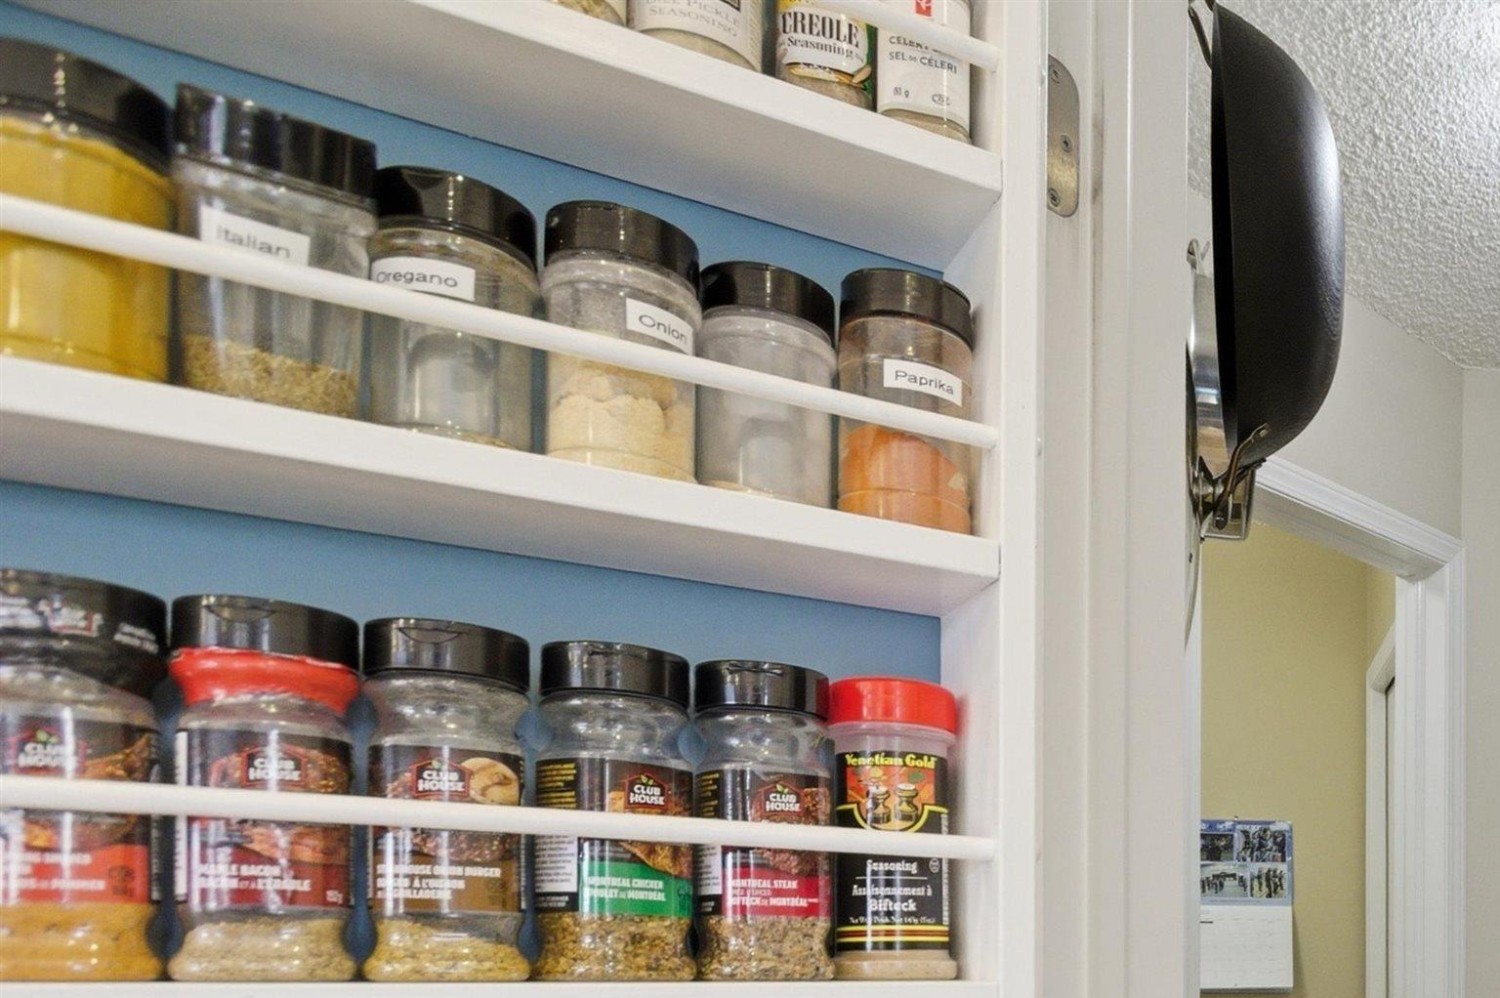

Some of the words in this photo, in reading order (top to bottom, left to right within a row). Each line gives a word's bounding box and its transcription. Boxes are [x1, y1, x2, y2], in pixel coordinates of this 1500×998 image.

[648, 6, 738, 37] SEASONING
[781, 11, 861, 48] CREOLE
[786, 35, 858, 60] Seasoning
[888, 51, 907, 61] SEL
[216, 224, 291, 261] Italian
[638, 313, 687, 342] Onion
[893, 368, 955, 398] Paprika
[845, 752, 904, 768] Venetian
[904, 752, 936, 770] Gold
[417, 779, 468, 793] HOUSE
[633, 784, 661, 795] CLUB
[629, 793, 666, 806] HOUSE
[768, 793, 797, 804] CLUB
[765, 801, 801, 813] HOUSE
[865, 859, 918, 875] Seasoning
[773, 880, 798, 889] STEAK
[868, 898, 917, 912] Bifteck
